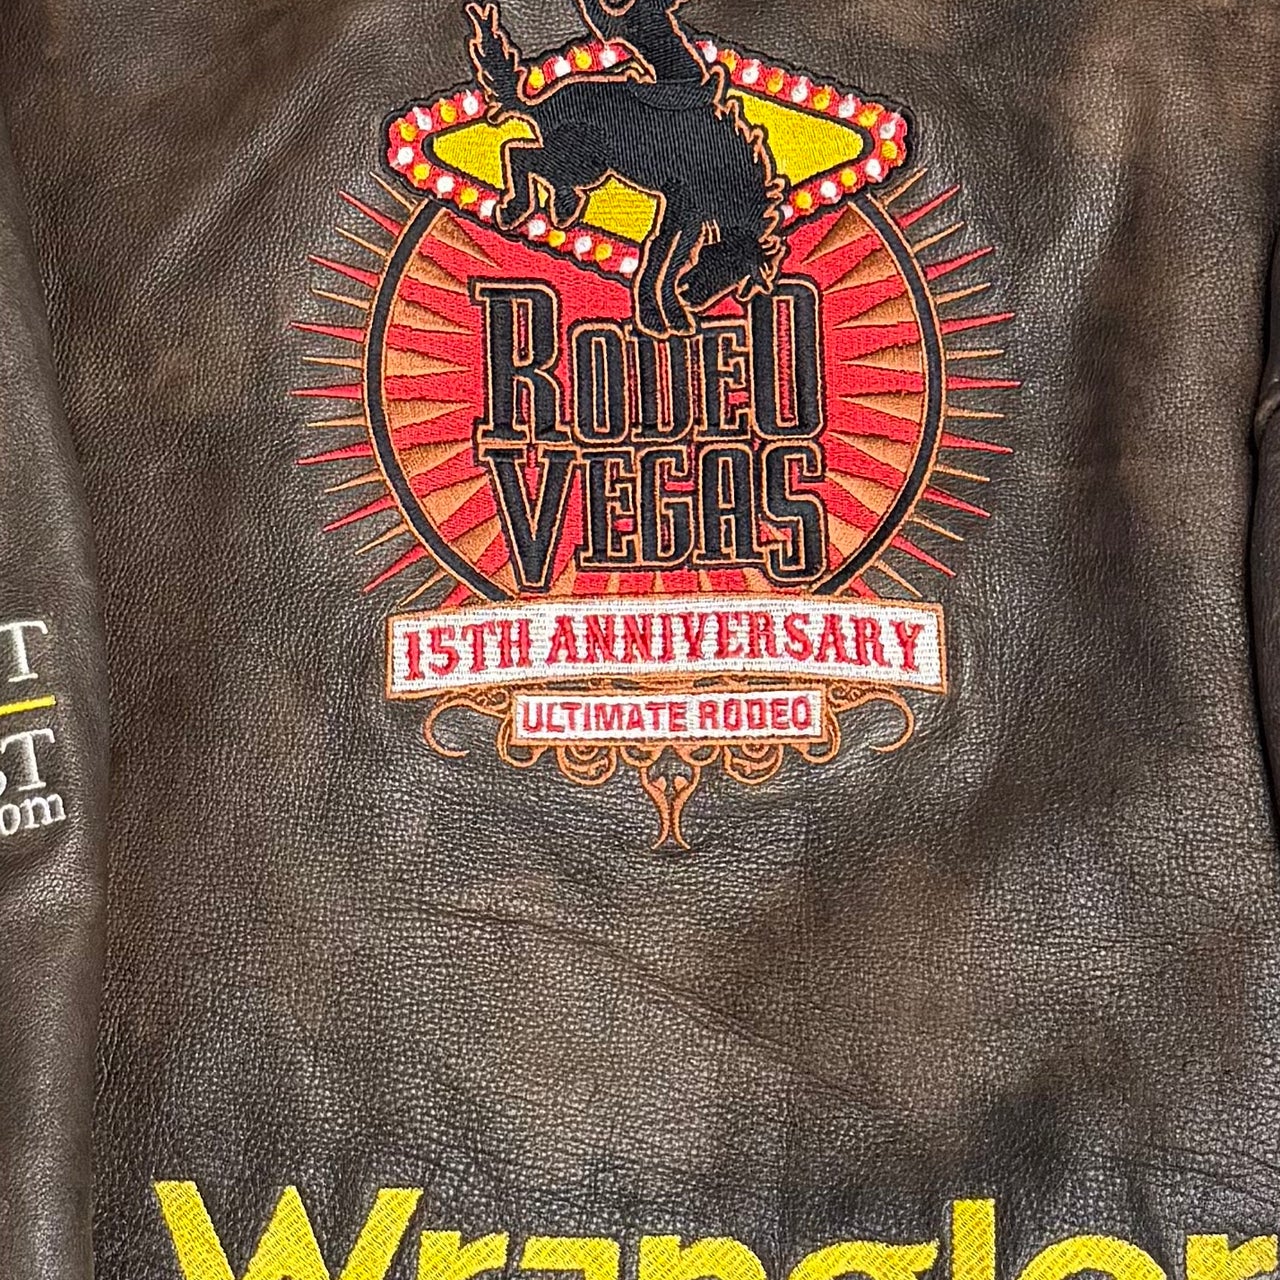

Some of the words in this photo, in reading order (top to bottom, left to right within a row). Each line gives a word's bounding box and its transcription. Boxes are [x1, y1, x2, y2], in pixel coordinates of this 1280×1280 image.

[468, 277, 824, 444] RODEO
[475, 440, 828, 592] VEGAS
[402, 619, 531, 682] 15TH
[546, 613, 924, 671] ANNIVERSARY
[521, 701, 687, 735] ULTIMATE
[700, 695, 814, 731] RODEO
